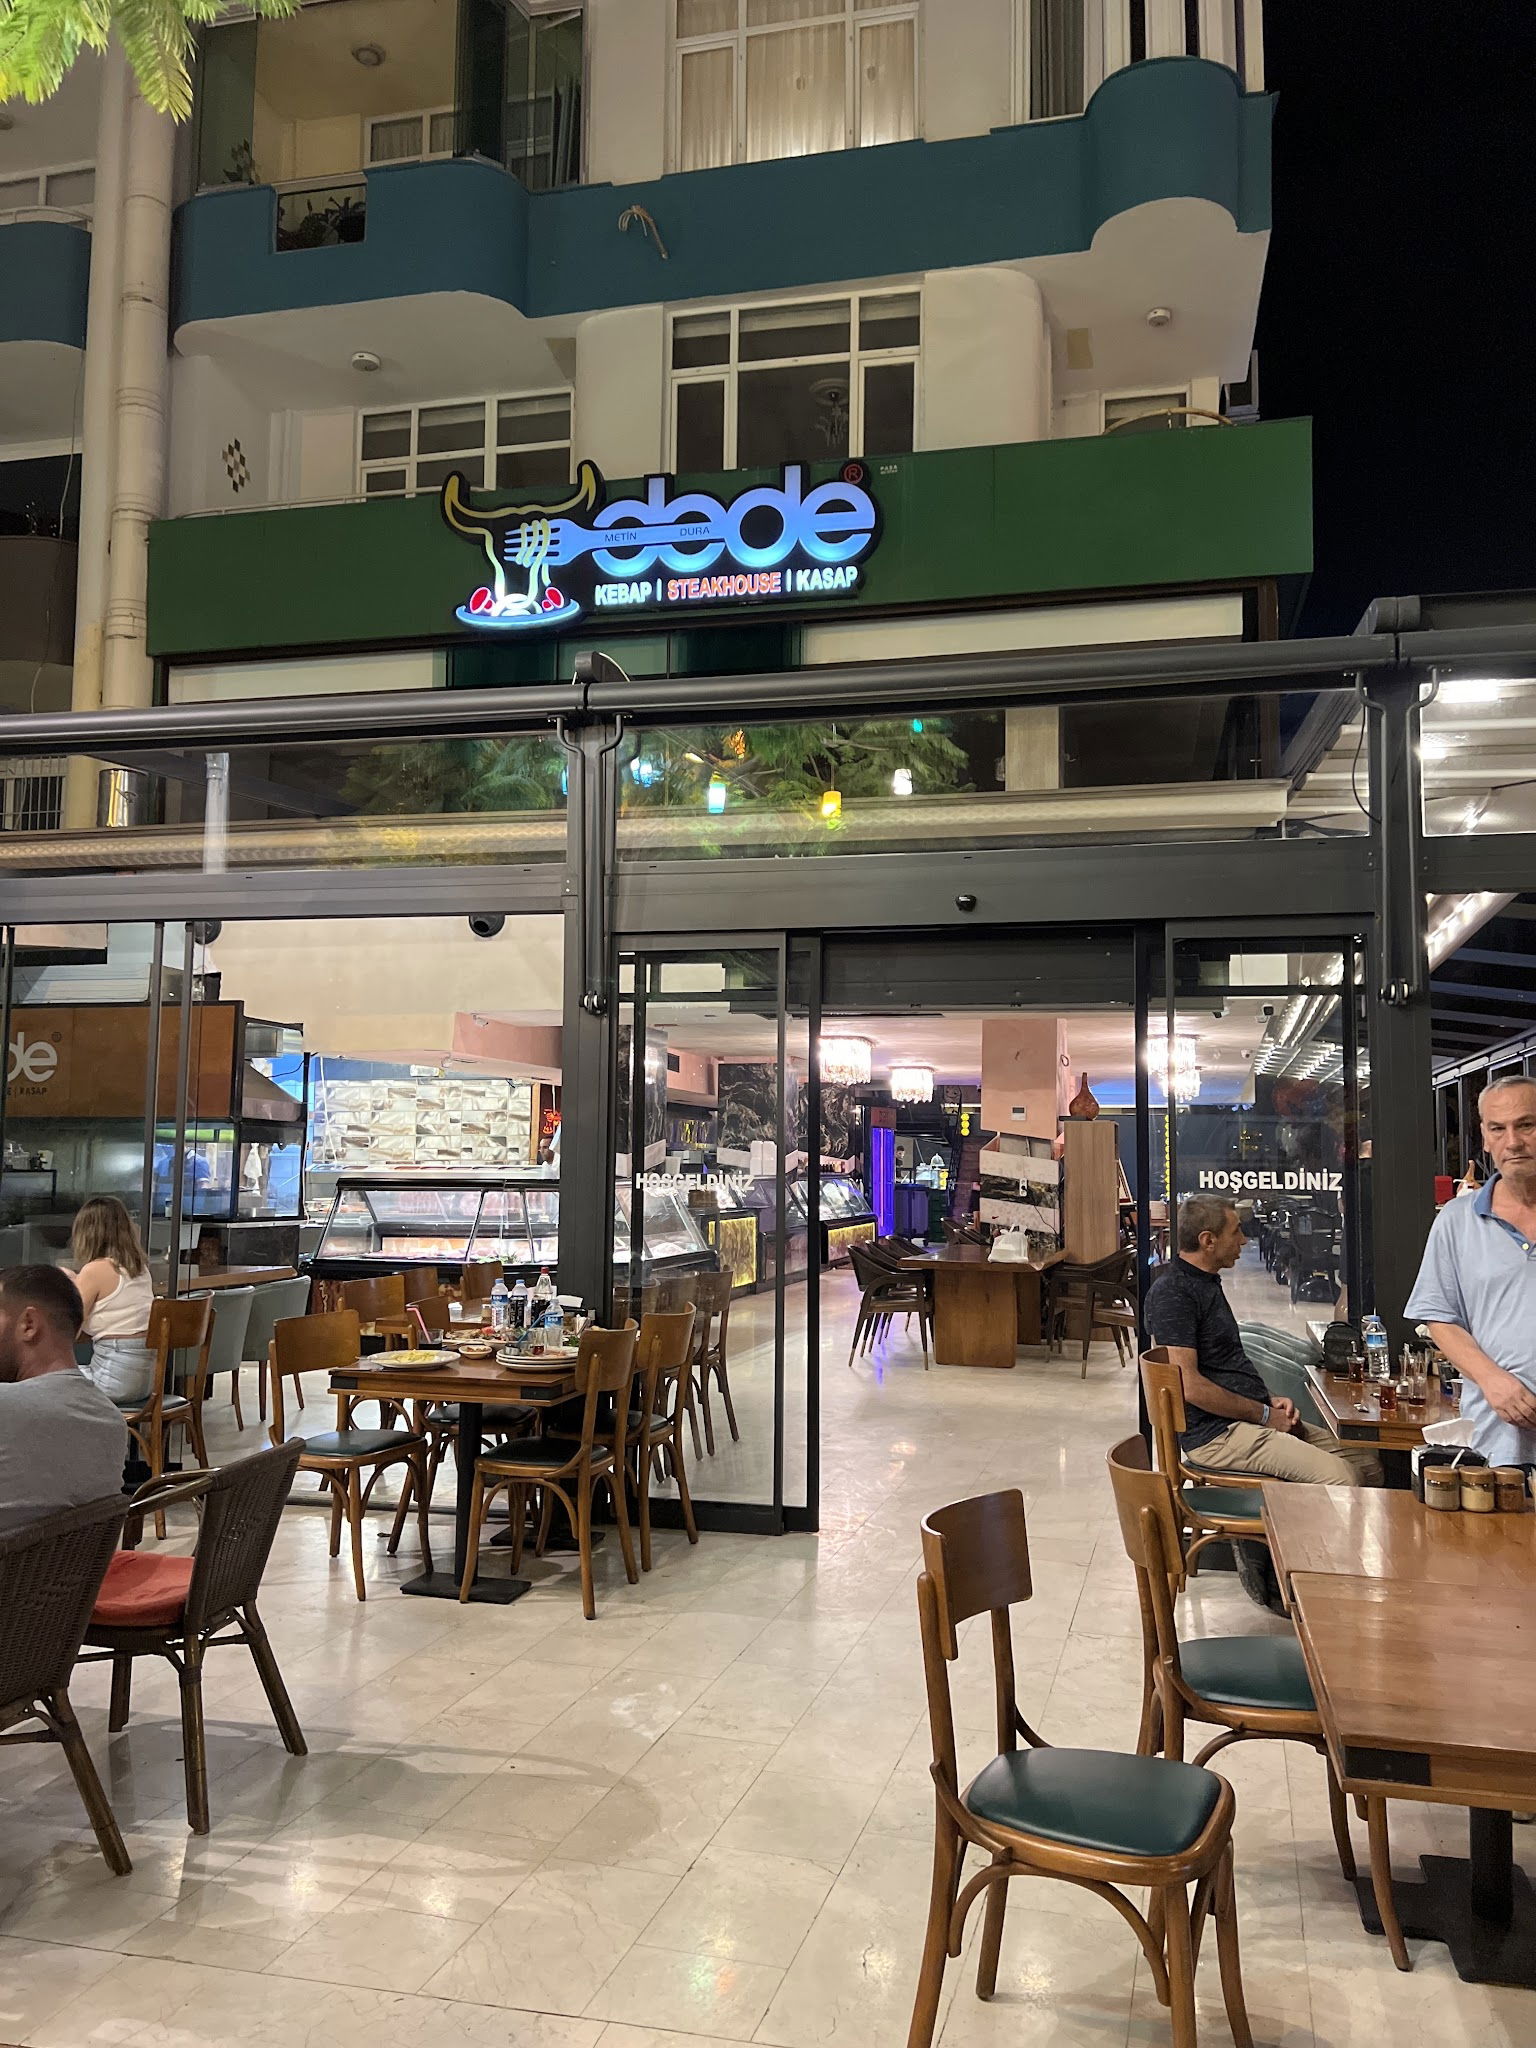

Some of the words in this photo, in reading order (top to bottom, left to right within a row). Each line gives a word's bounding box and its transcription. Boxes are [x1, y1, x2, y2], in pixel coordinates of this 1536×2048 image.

[604, 531, 637, 542] METİN
[680, 526, 710, 536] DURA
[594, 581, 653, 606] KEBAP
[667, 571, 782, 600] STEAKHOUSE
[796, 566, 858, 591] KASAP
[1199, 1167, 1344, 1194] HOŞGELDİNİZ
